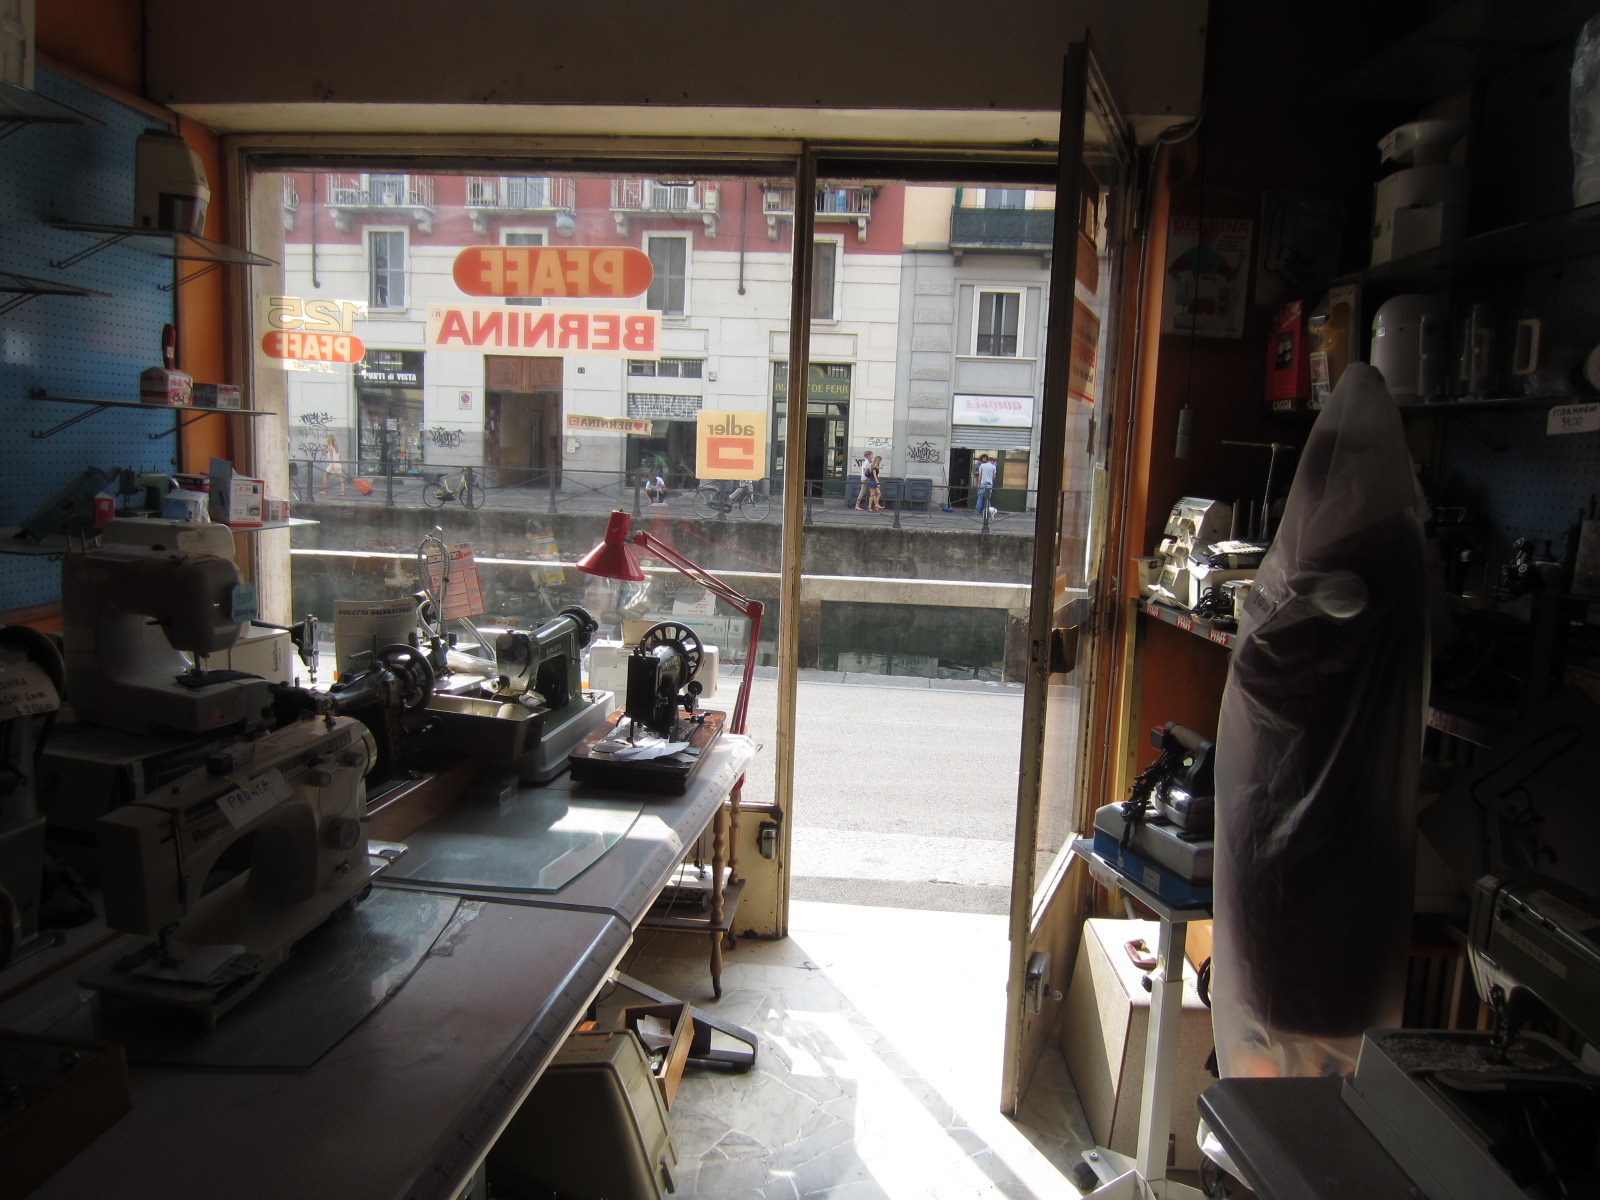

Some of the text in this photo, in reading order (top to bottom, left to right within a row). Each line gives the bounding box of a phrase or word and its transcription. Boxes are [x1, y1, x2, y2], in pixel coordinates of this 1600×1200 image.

[396, 373, 417, 381] VISTA
[811, 384, 823, 392] DE
[1177, 616, 1192, 631] PFAFF
[1210, 629, 1227, 645] PFAFF
